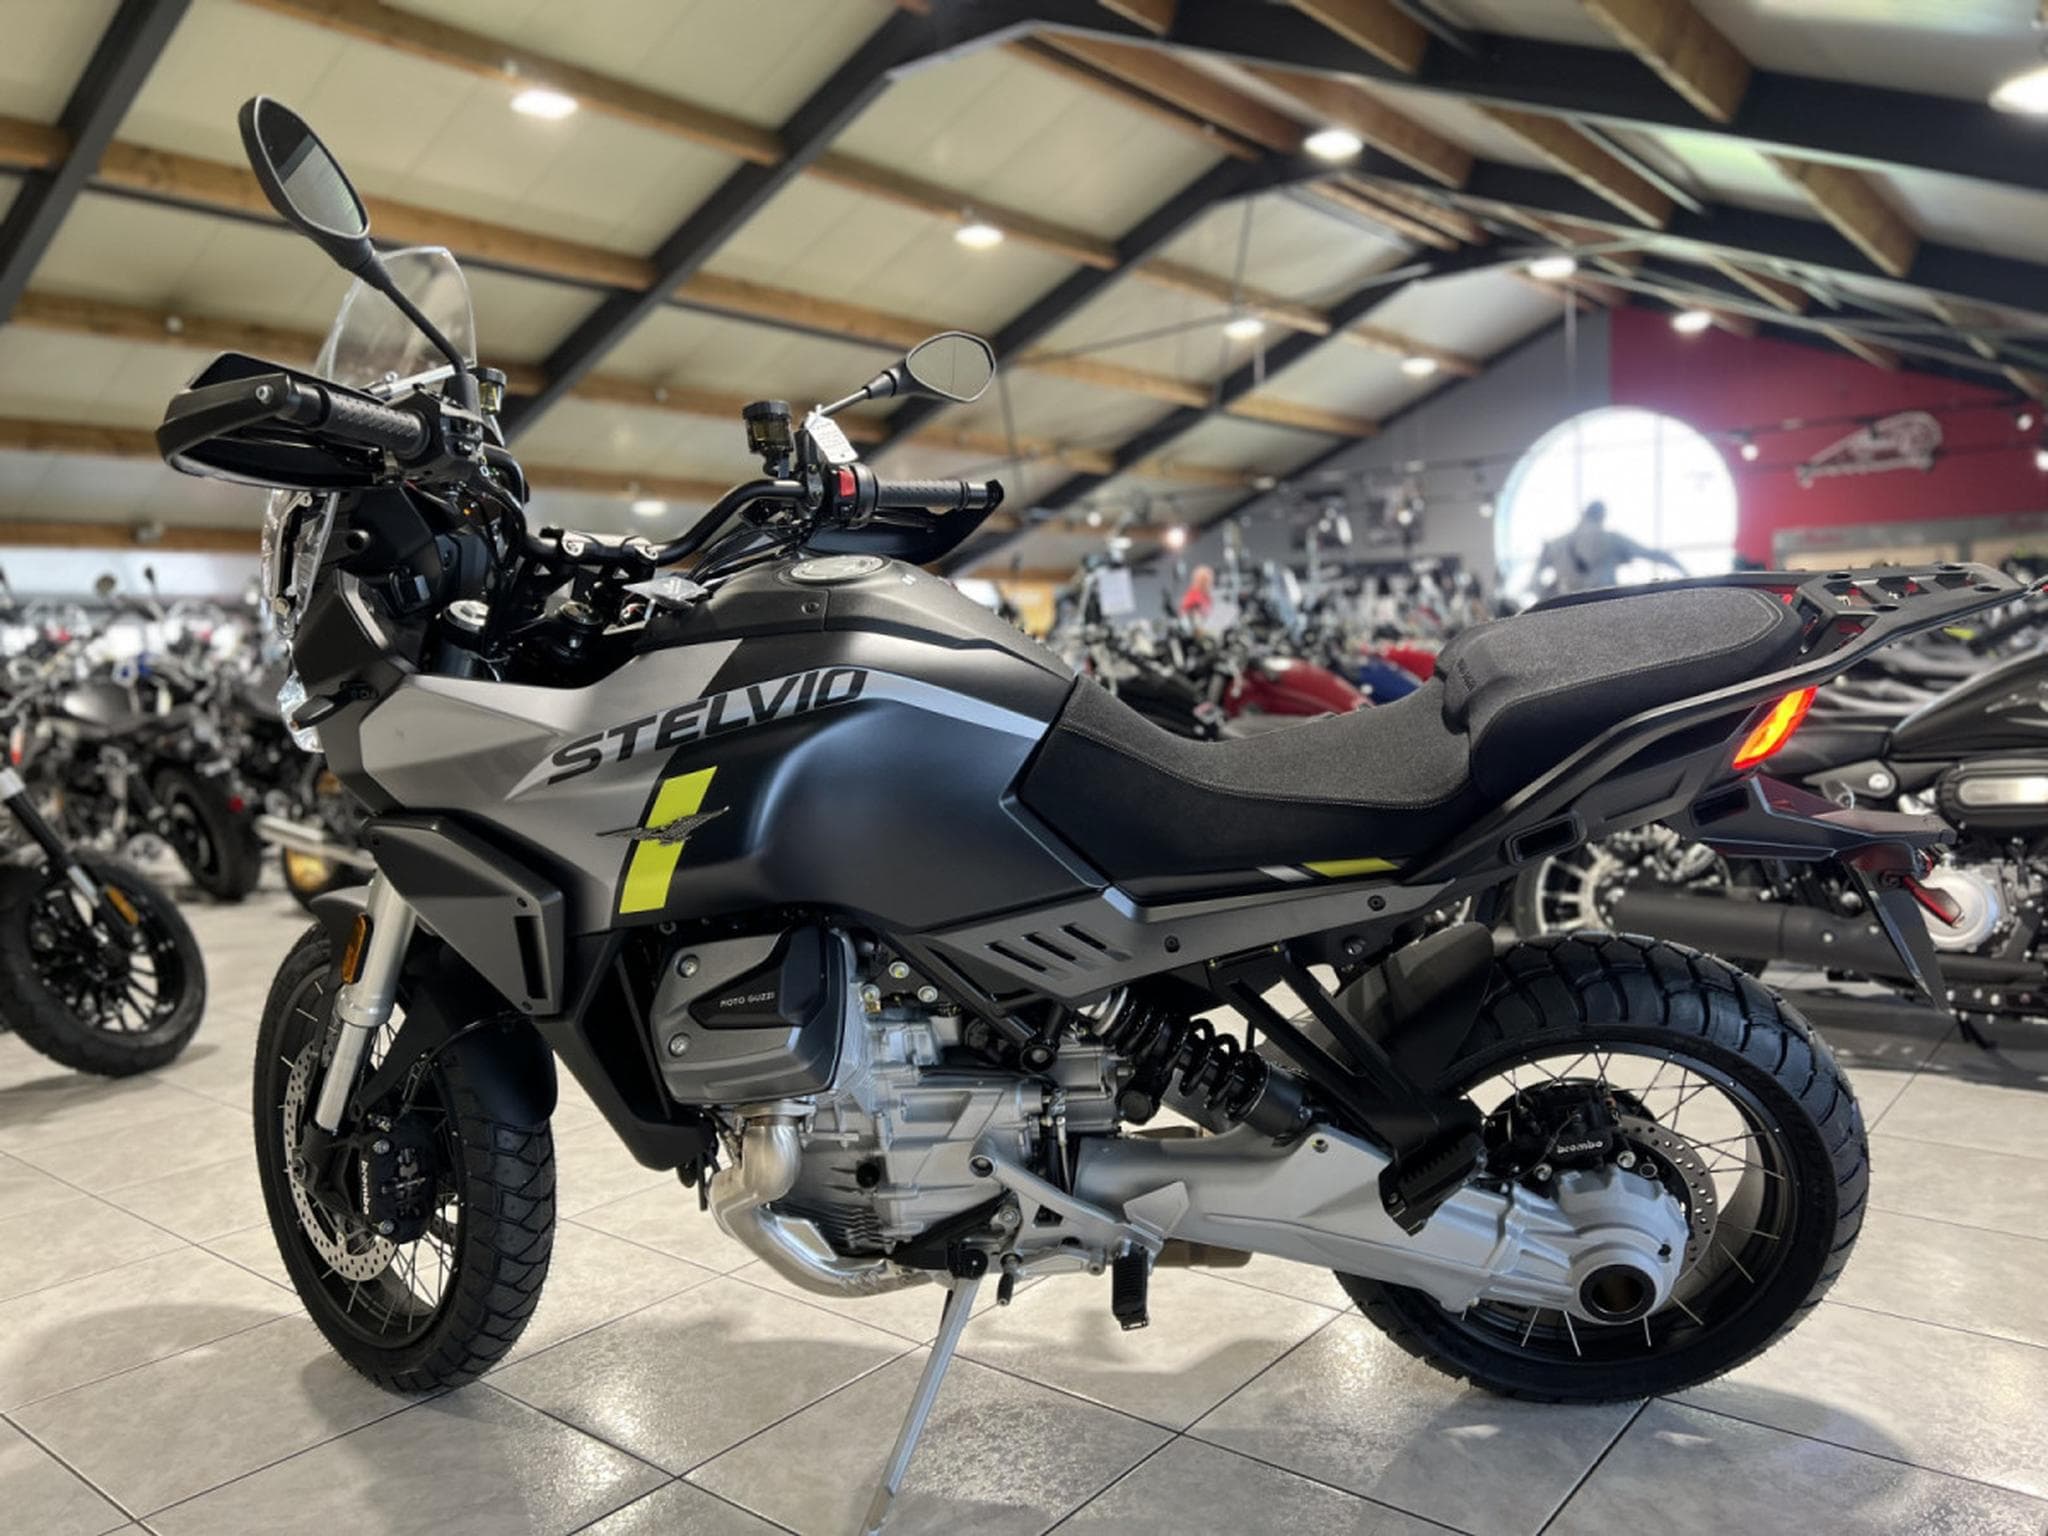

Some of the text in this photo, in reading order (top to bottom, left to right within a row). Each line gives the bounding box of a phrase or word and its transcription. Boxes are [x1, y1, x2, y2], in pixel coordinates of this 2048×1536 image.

[547, 668, 868, 785] STELVIO
[720, 992, 775, 1007] MOTO GUZZI
[1557, 1140, 1603, 1154] brembo
[361, 1160, 370, 1215] brembo
